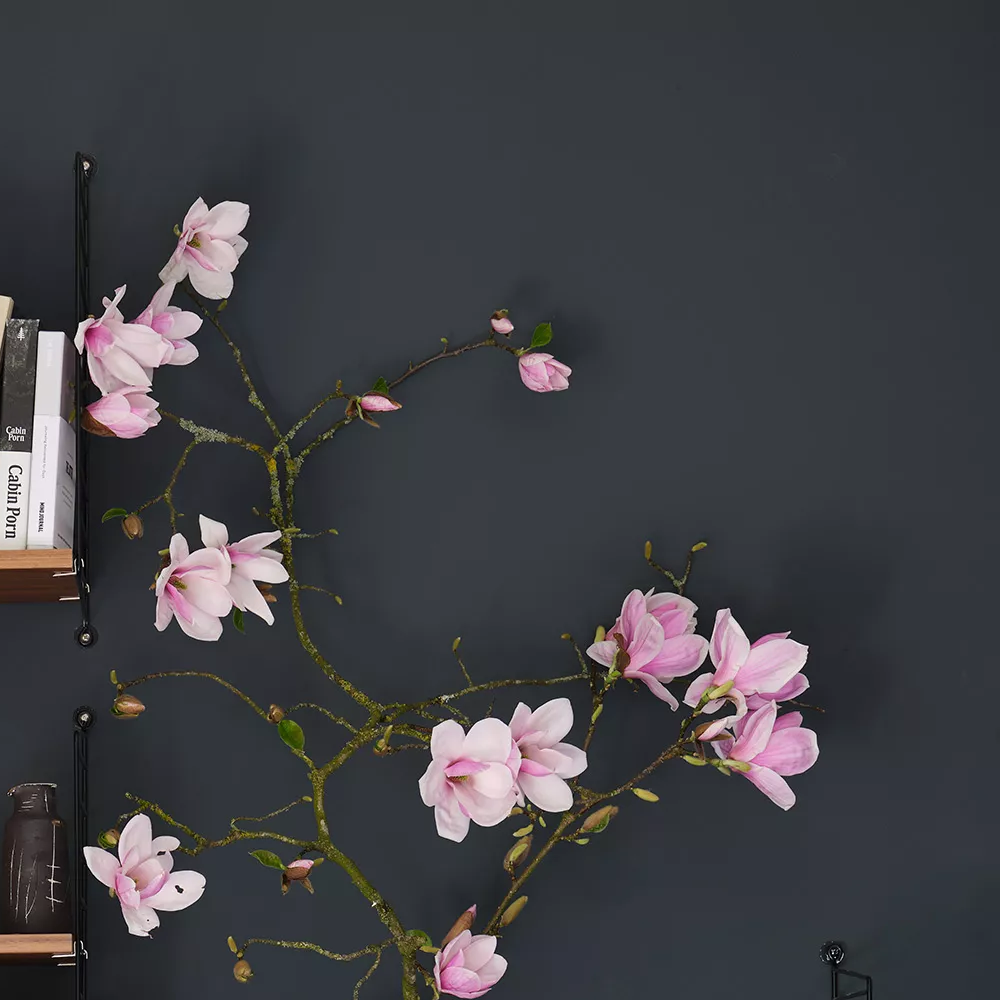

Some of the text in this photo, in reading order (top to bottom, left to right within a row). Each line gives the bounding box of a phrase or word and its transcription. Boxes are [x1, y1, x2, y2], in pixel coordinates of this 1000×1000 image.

[5, 426, 27, 434] Cabin
[5, 464, 23, 539] Cabin Porn
